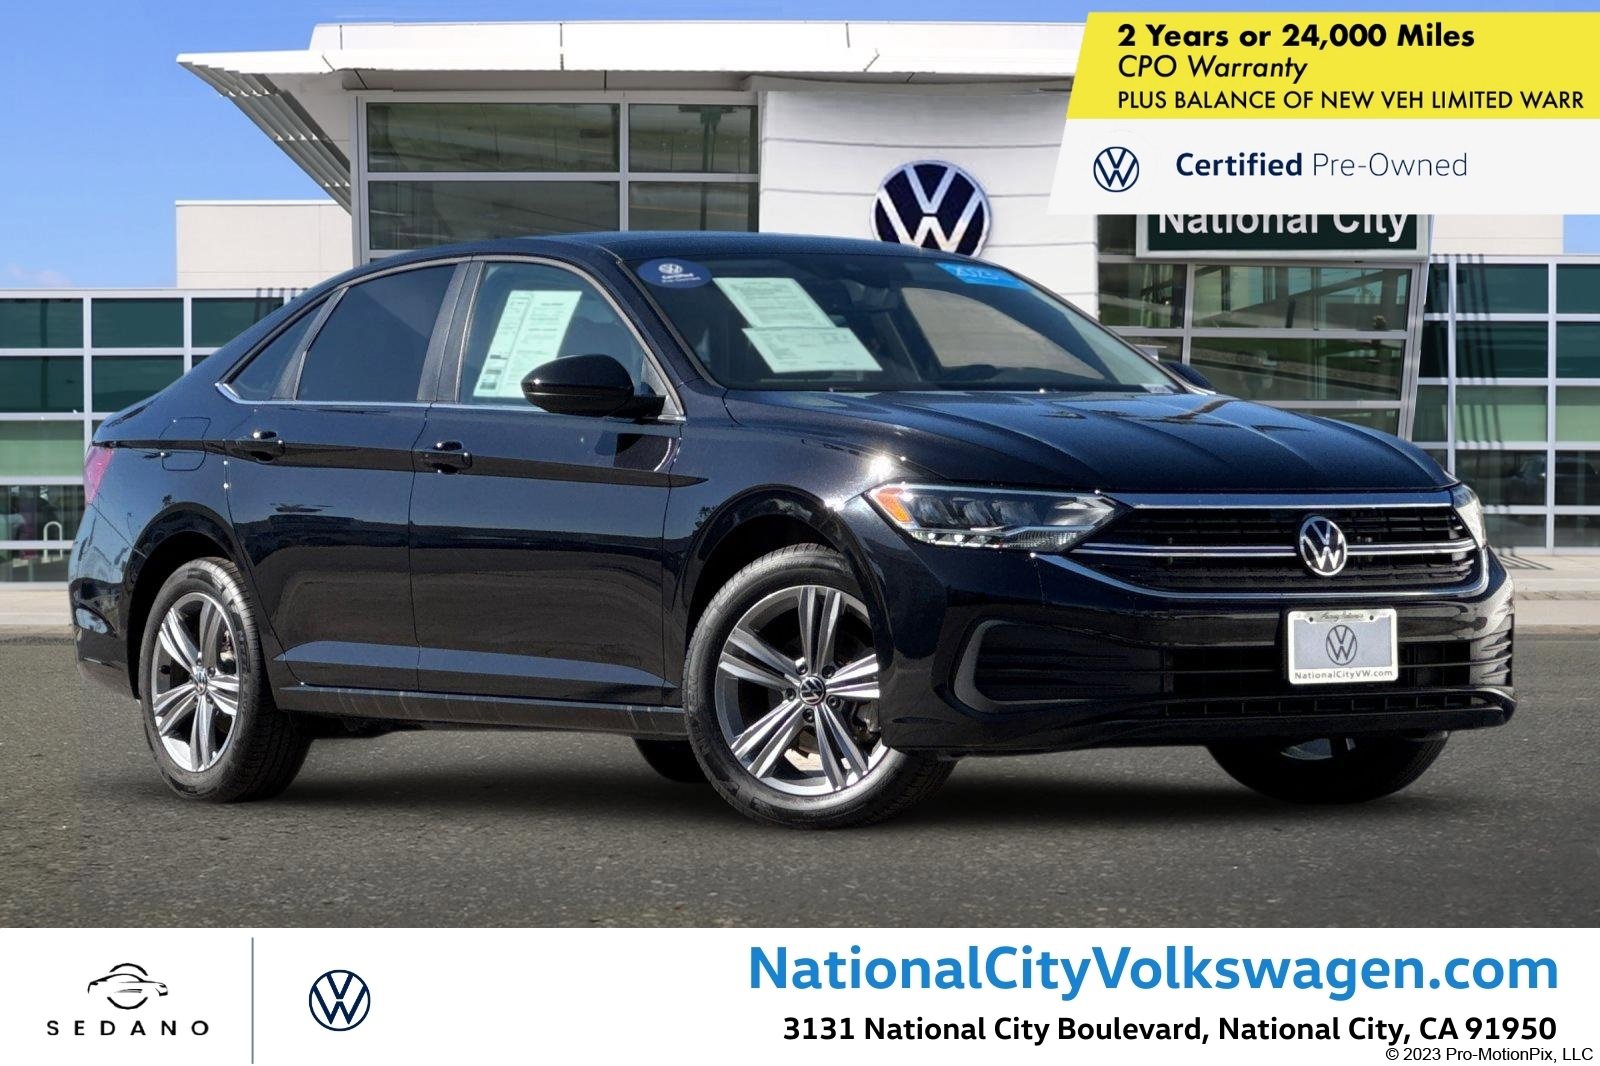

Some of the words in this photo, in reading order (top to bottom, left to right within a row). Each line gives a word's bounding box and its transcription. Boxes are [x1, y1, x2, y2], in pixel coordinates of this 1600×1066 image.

[1158, 214, 1318, 234] National
[1332, 214, 1409, 243] City
[1294, 670, 1393, 680] NationalCityVW.com
